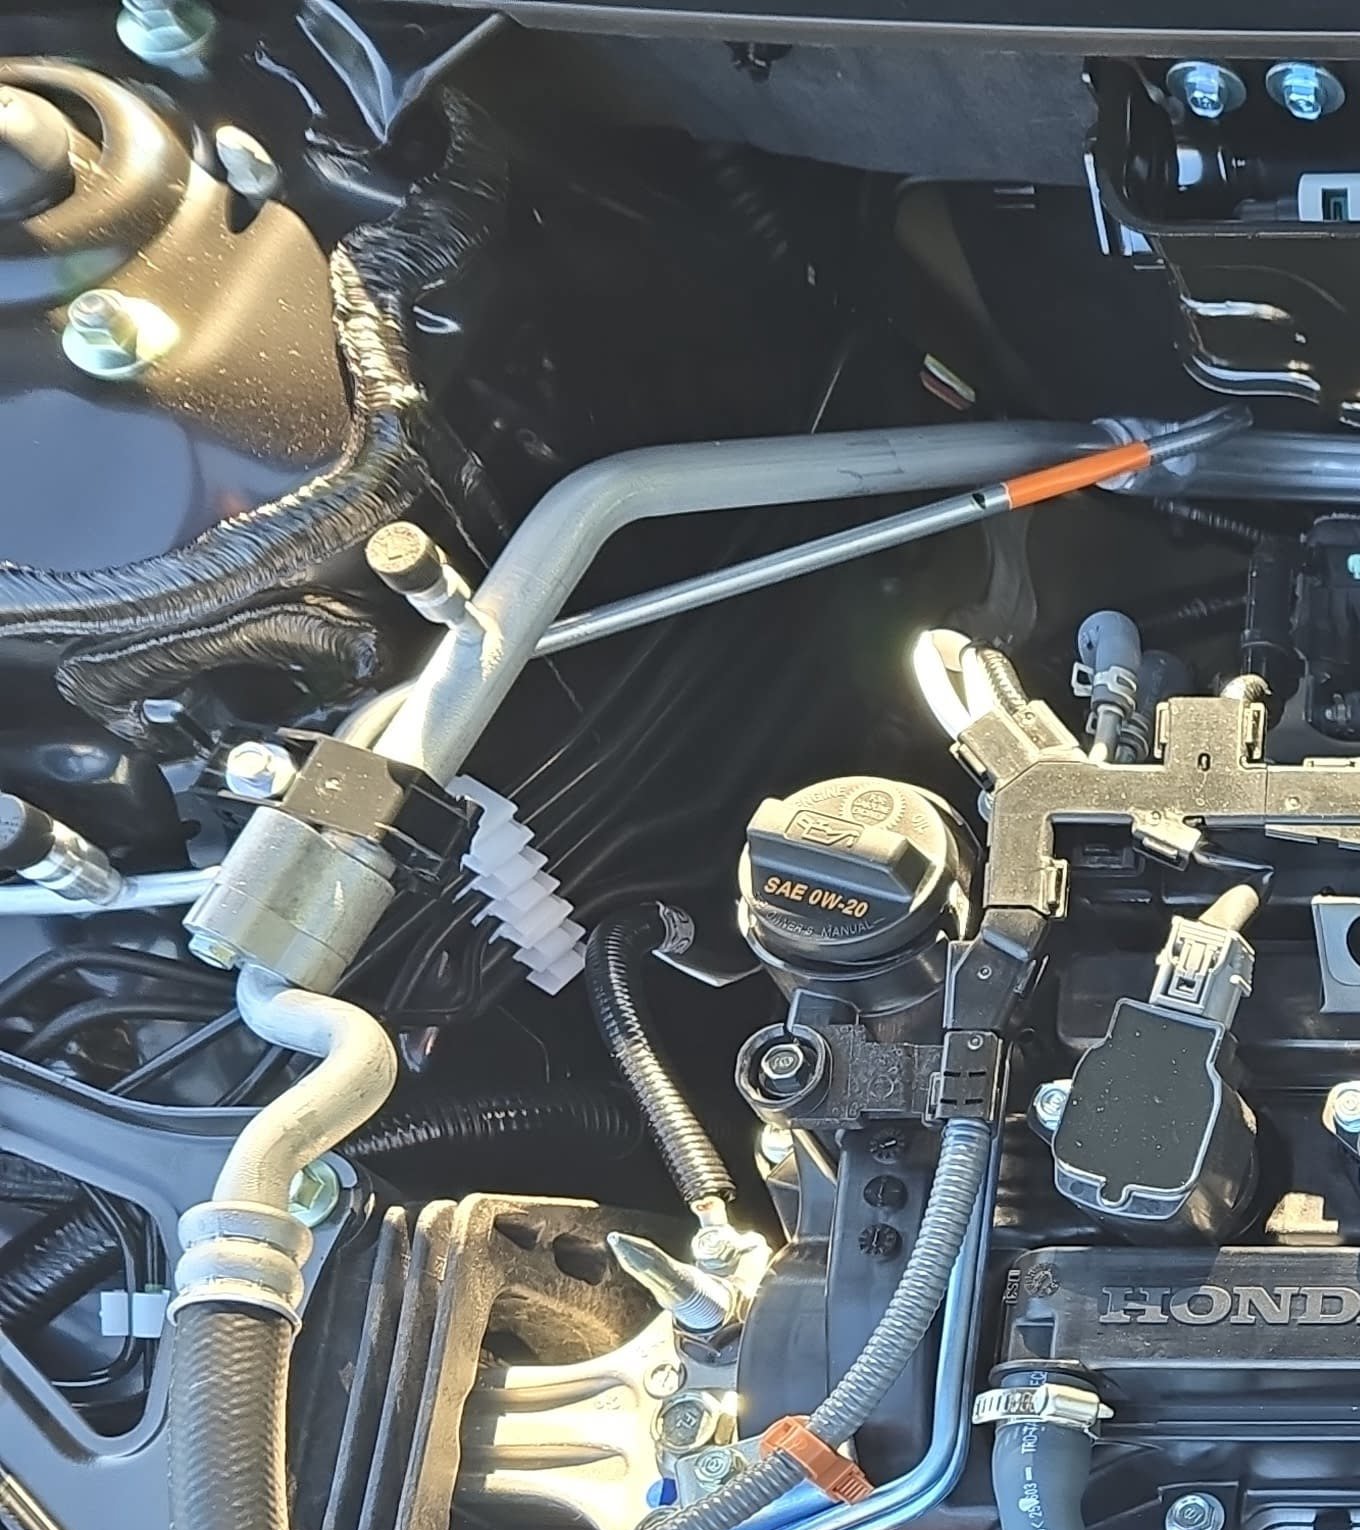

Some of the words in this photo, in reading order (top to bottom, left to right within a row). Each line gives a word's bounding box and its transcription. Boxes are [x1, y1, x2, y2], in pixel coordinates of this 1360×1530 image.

[764, 876, 808, 901] SAE
[808, 889, 869, 918] 0W-20
[820, 921, 875, 938] MANUAL
